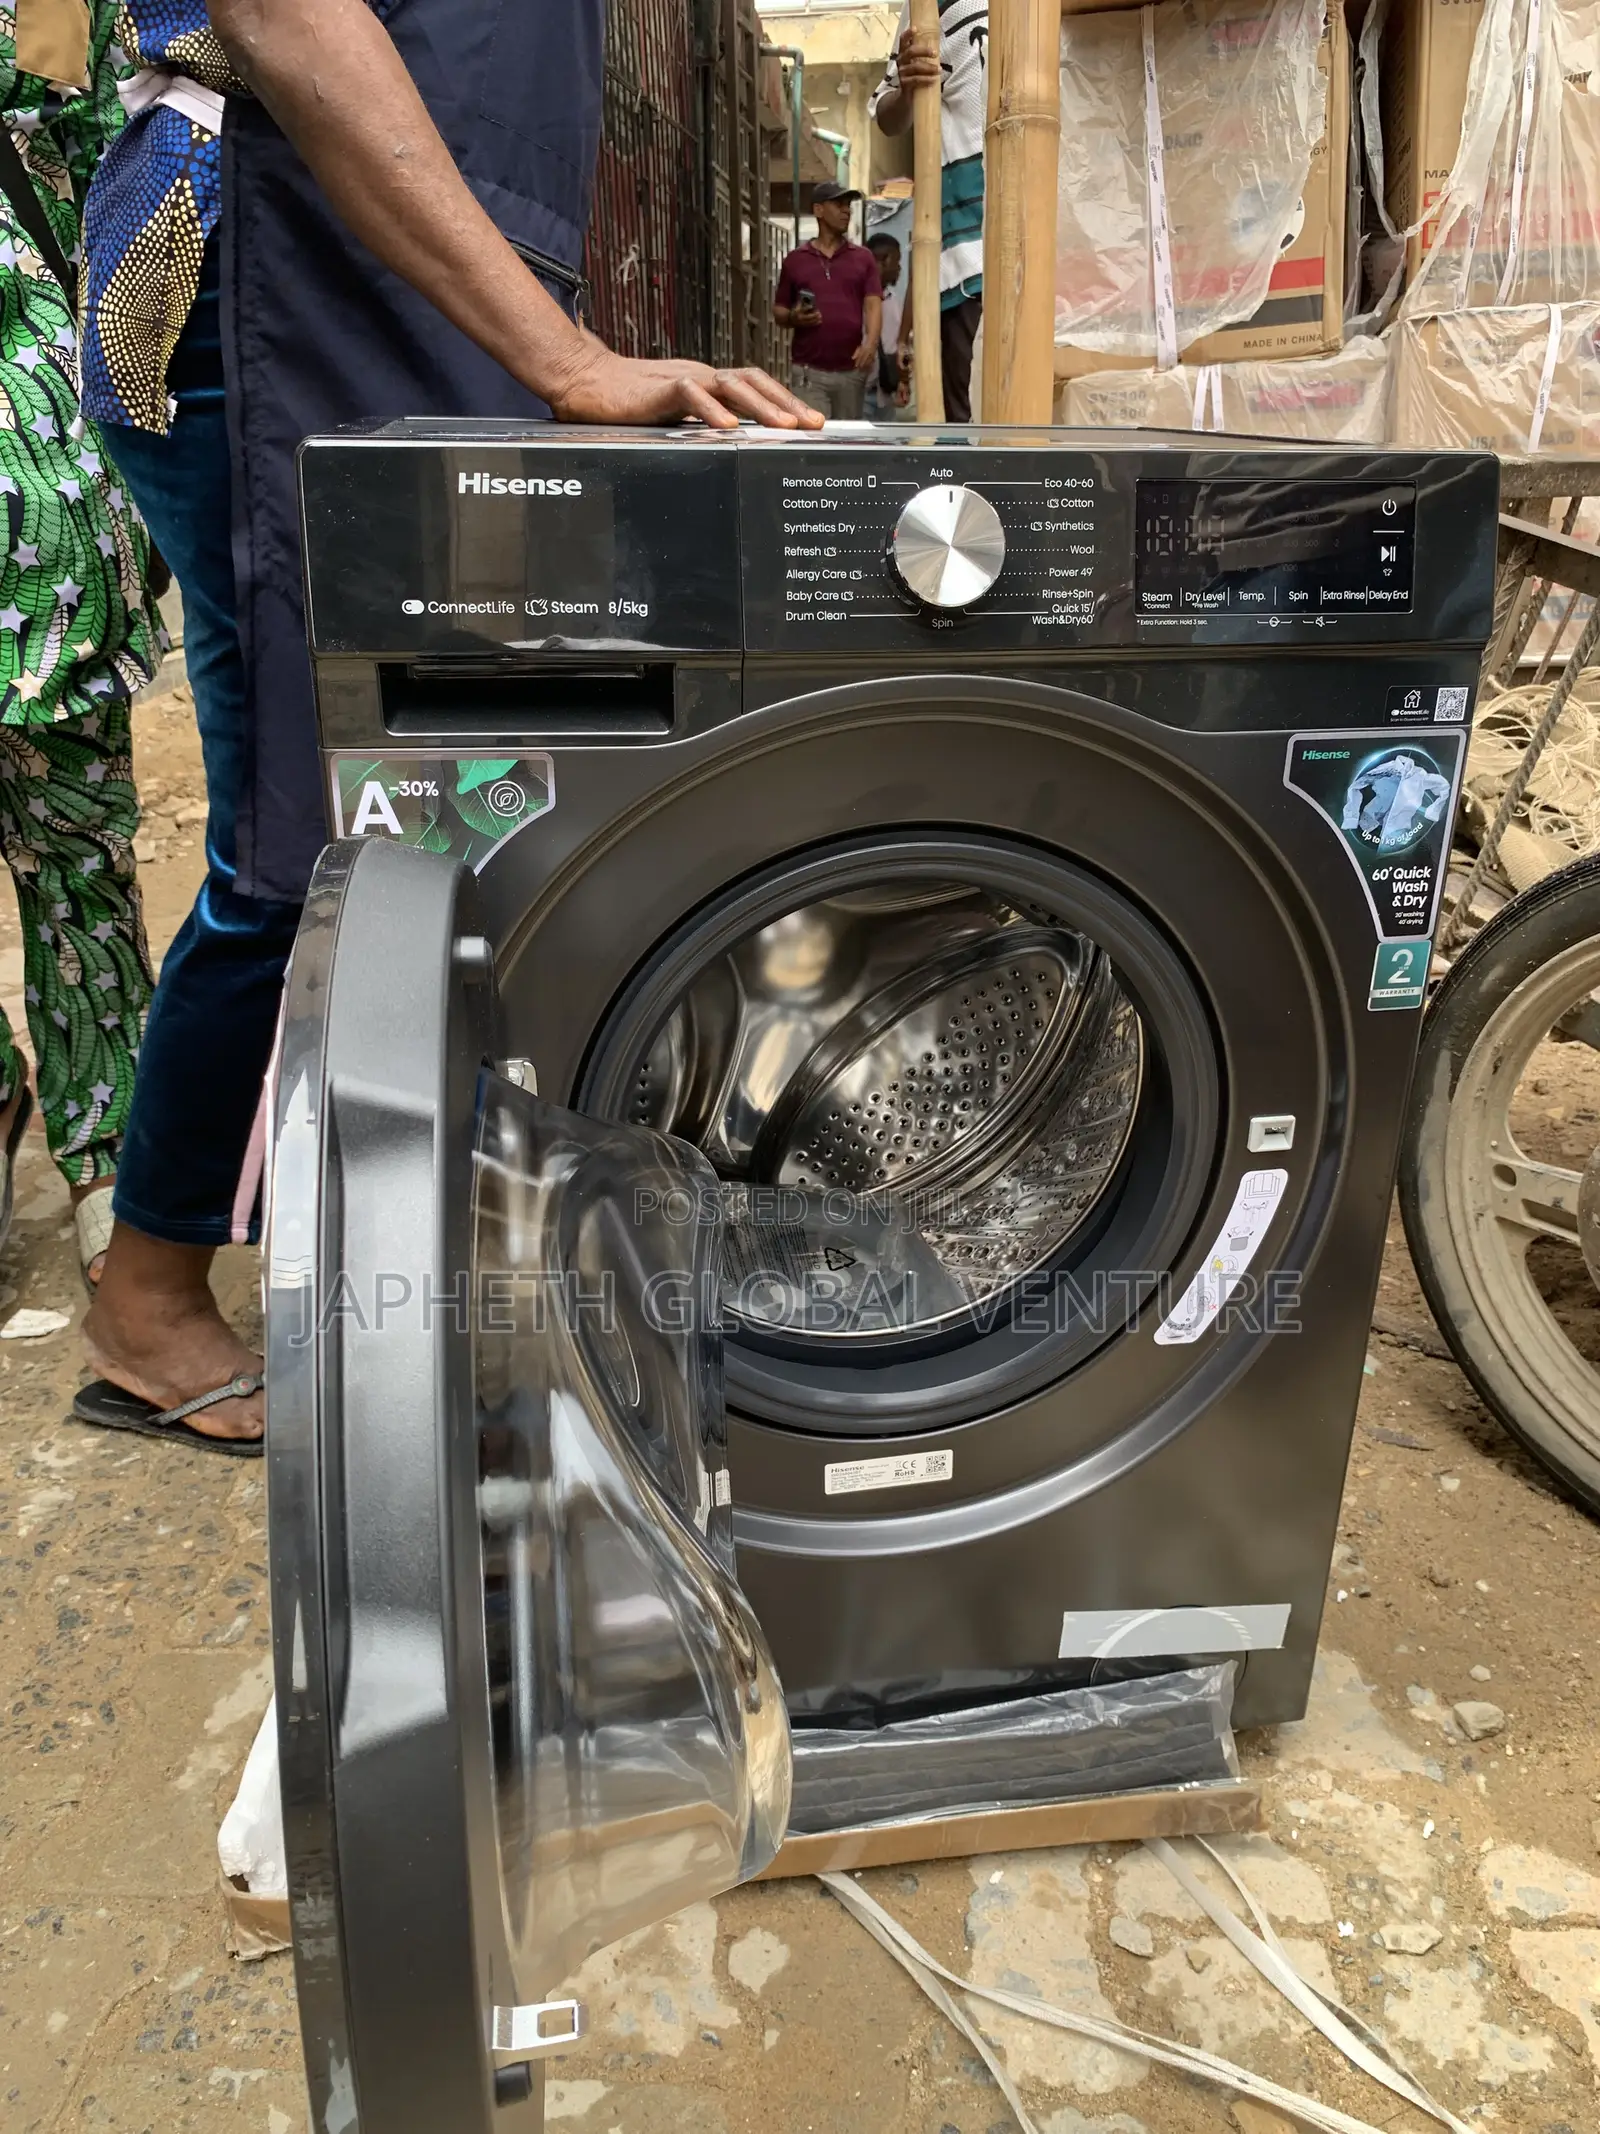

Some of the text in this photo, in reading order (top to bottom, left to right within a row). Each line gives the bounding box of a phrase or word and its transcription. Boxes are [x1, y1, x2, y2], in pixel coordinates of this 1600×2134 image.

[1243, 333, 1323, 349] MADE IN CHINA
[930, 468, 954, 479] Auto
[458, 471, 582, 496] Hisense
[782, 477, 863, 488] Remote Control
[1045, 478, 1094, 488] Eco 40-60
[782, 499, 839, 511] Cotton Dry
[1061, 498, 1094, 509] Cotton
[784, 523, 856, 535] Synthetics Dry
[1045, 521, 1094, 533] Synthetics
[784, 546, 821, 557] Refresh
[1070, 545, 1094, 555] Wool
[786, 568, 847, 582] Allergy Care
[1049, 568, 1078, 578] Power
[786, 590, 839, 603] Baby Care
[1042, 589, 1094, 601] Rinse+Spin
[1142, 592, 1173, 602] Steam
[1185, 591, 1226, 603] Dry Level
[1238, 591, 1266, 603] Temp.
[1288, 590, 1309, 603] Spin
[1323, 590, 1365, 601] Extra Rinse
[1369, 590, 1409, 603] Delay End
[427, 601, 516, 614] ConnectLife
[551, 598, 649, 617] Steam 8/5kg
[1052, 603, 1079, 614] Quick
[785, 610, 847, 621] Drum Clean
[1032, 614, 1095, 627] Wash&Dry60'
[931, 618, 954, 629] Spin
[1302, 749, 1351, 761] Hisense
[351, 781, 405, 835] A
[1361, 829, 1372, 841] Up
[1372, 836, 1381, 845] to
[1385, 838, 1395, 846] kg
[1397, 833, 1406, 843] of
[1406, 822, 1424, 839] load
[1393, 866, 1432, 880] Quick
[1392, 881, 1429, 894] Wash
[1392, 894, 1427, 909] & Dry
[1403, 910, 1425, 919] washing
[1387, 948, 1414, 984] 2
[1379, 988, 1416, 996] WARRANTY
[831, 1465, 865, 1473] Hisense
